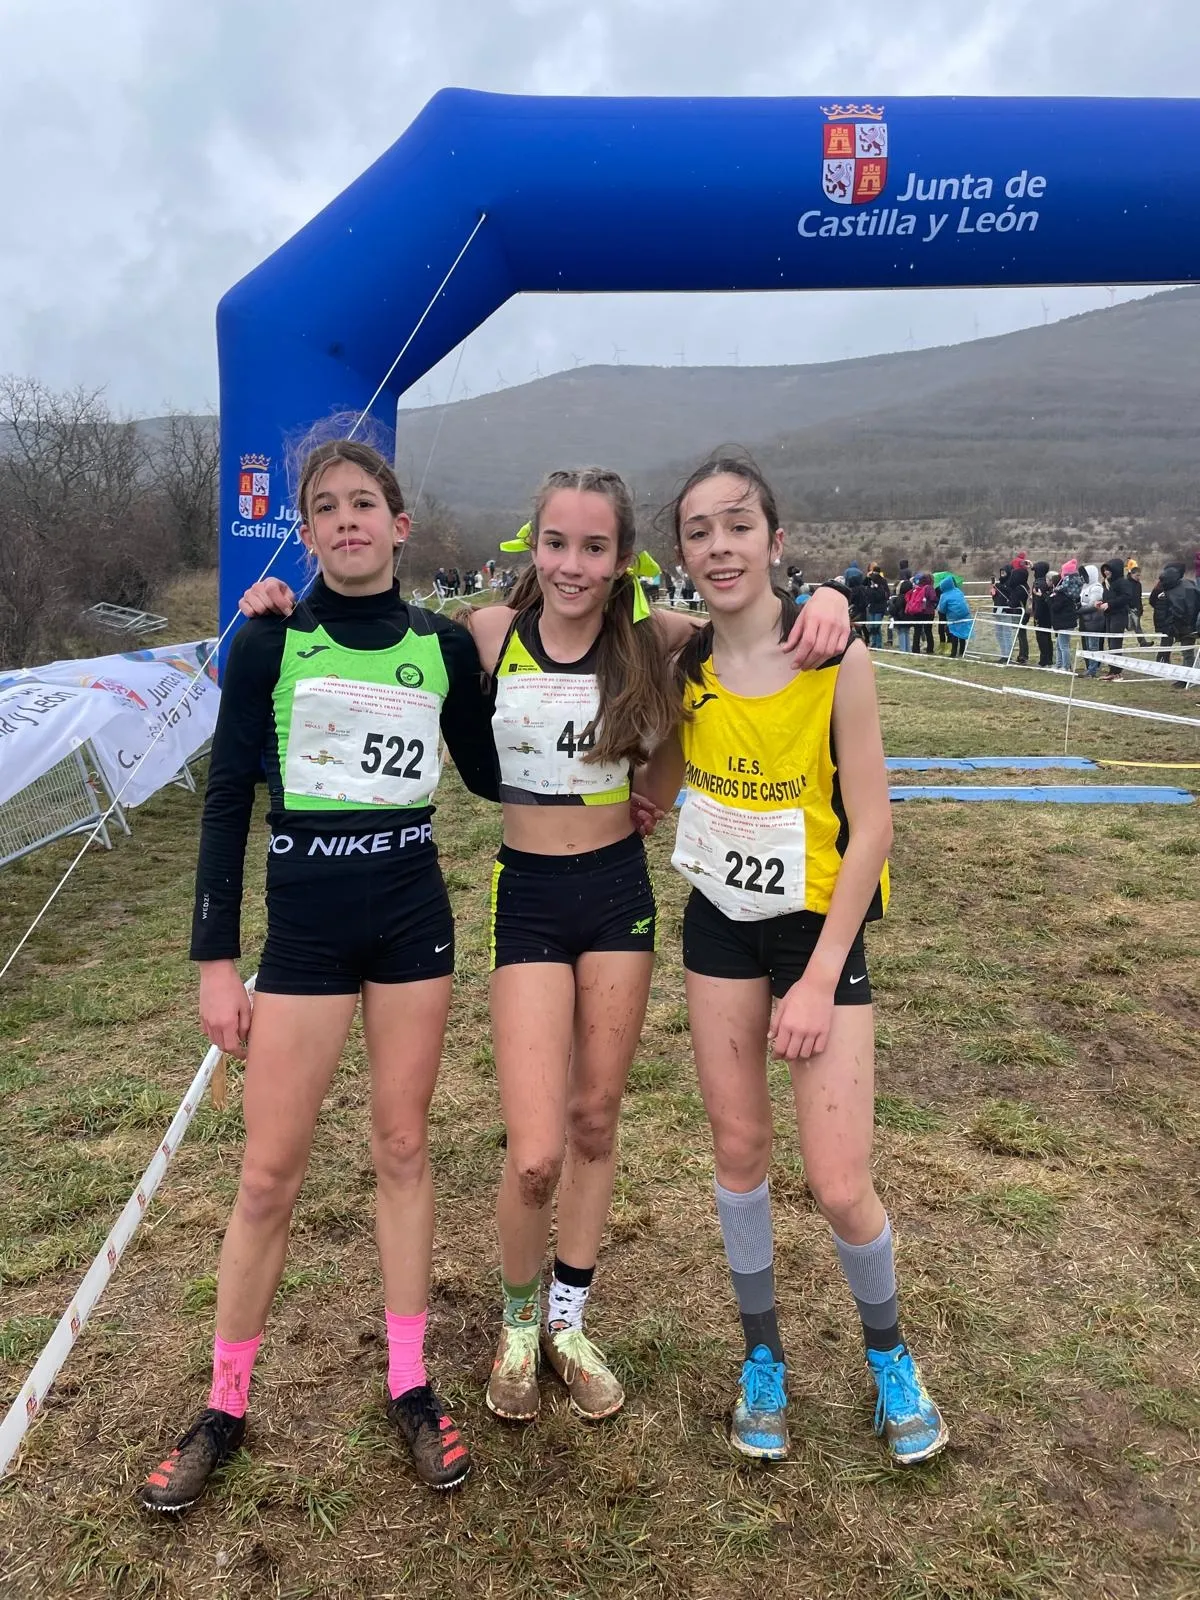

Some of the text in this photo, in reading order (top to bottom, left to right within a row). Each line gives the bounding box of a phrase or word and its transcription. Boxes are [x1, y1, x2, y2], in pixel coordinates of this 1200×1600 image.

[896, 170, 1046, 201] Junta de
[797, 204, 1039, 242] Castilla y León
[231, 521, 286, 539] Castilla
[8, 712, 39, 726] y
[360, 732, 425, 780] 522
[728, 756, 764, 776] I.E.S.
[742, 781, 758, 800] DE
[307, 831, 393, 856] NIKE
[725, 850, 785, 895] 222
